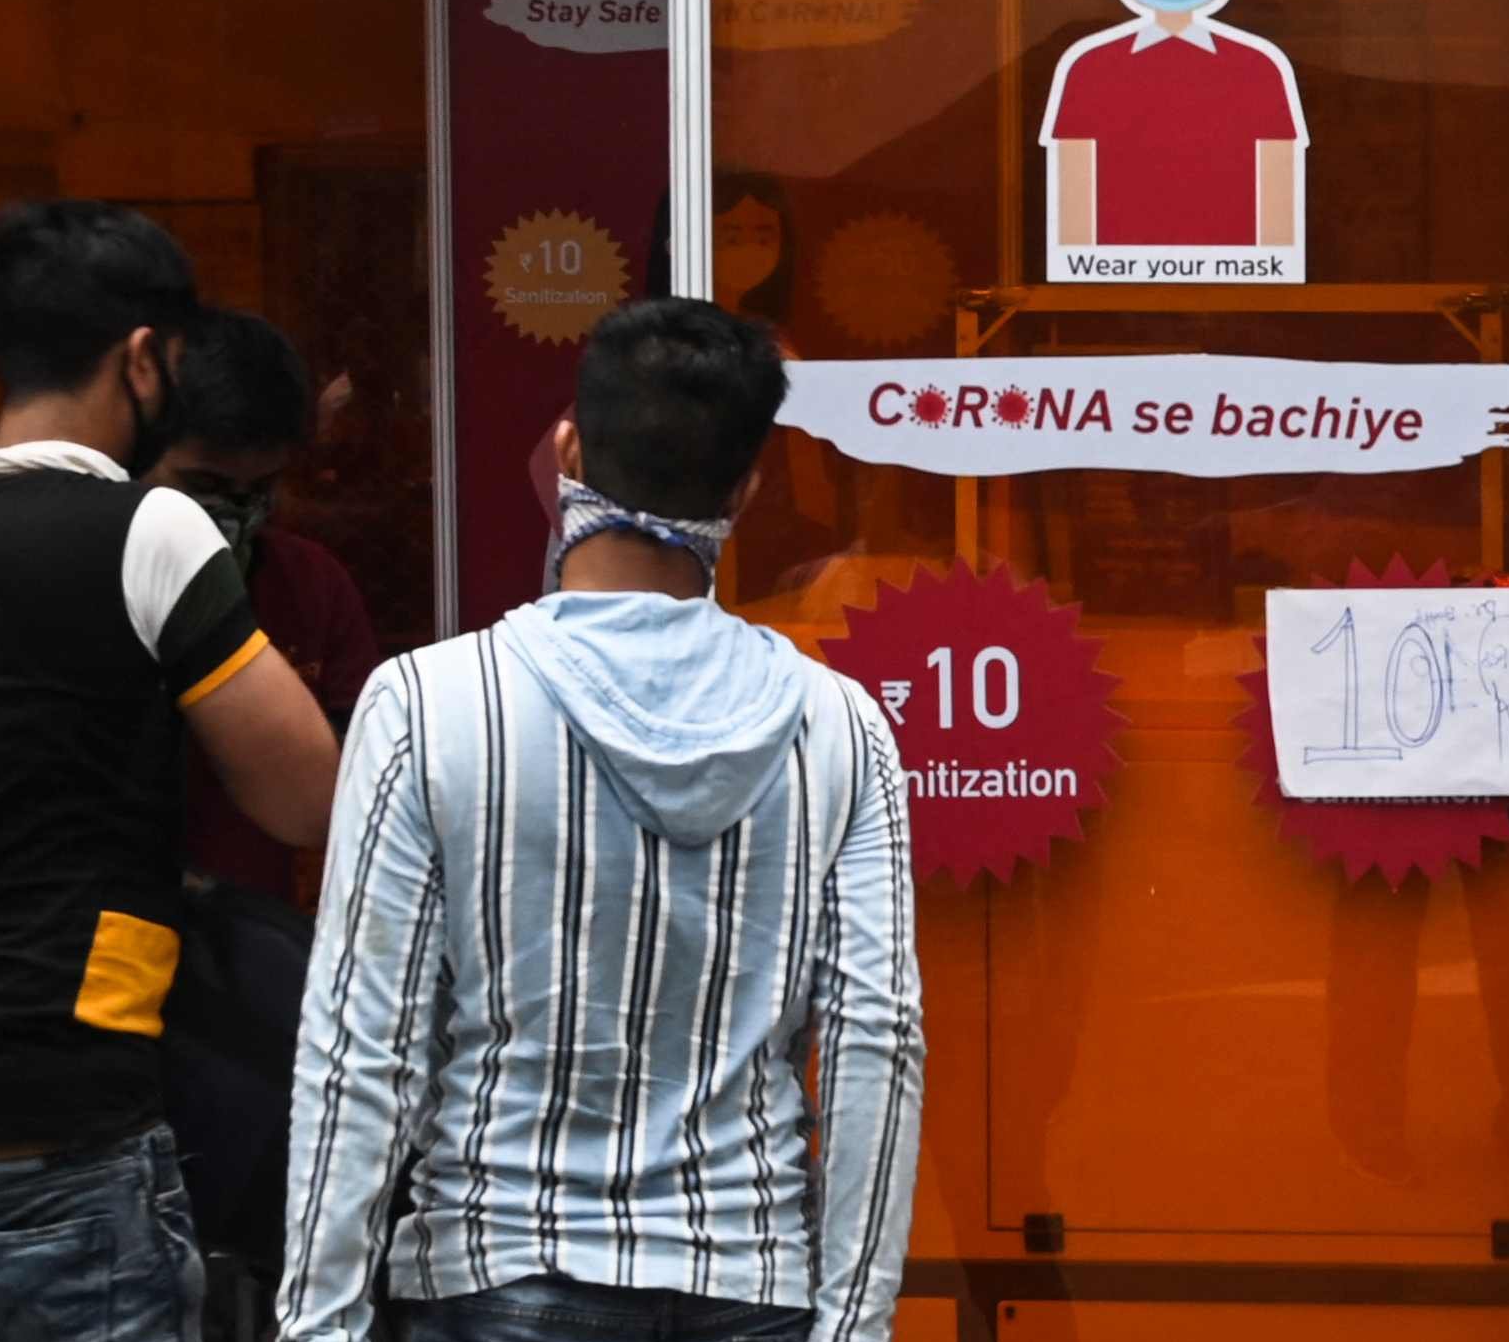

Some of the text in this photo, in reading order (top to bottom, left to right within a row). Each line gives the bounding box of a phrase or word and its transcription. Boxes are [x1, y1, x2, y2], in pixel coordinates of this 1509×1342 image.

[526, 0, 661, 27] Stay Safe
[539, 240, 584, 276] 10
[1067, 253, 1284, 282] Wear your mask
[505, 286, 609, 307] Sanitization
[1132, 396, 1195, 438] se
[1210, 392, 1425, 451] bachiye
[924, 645, 1021, 731] 10
[903, 756, 1078, 800] nitization
